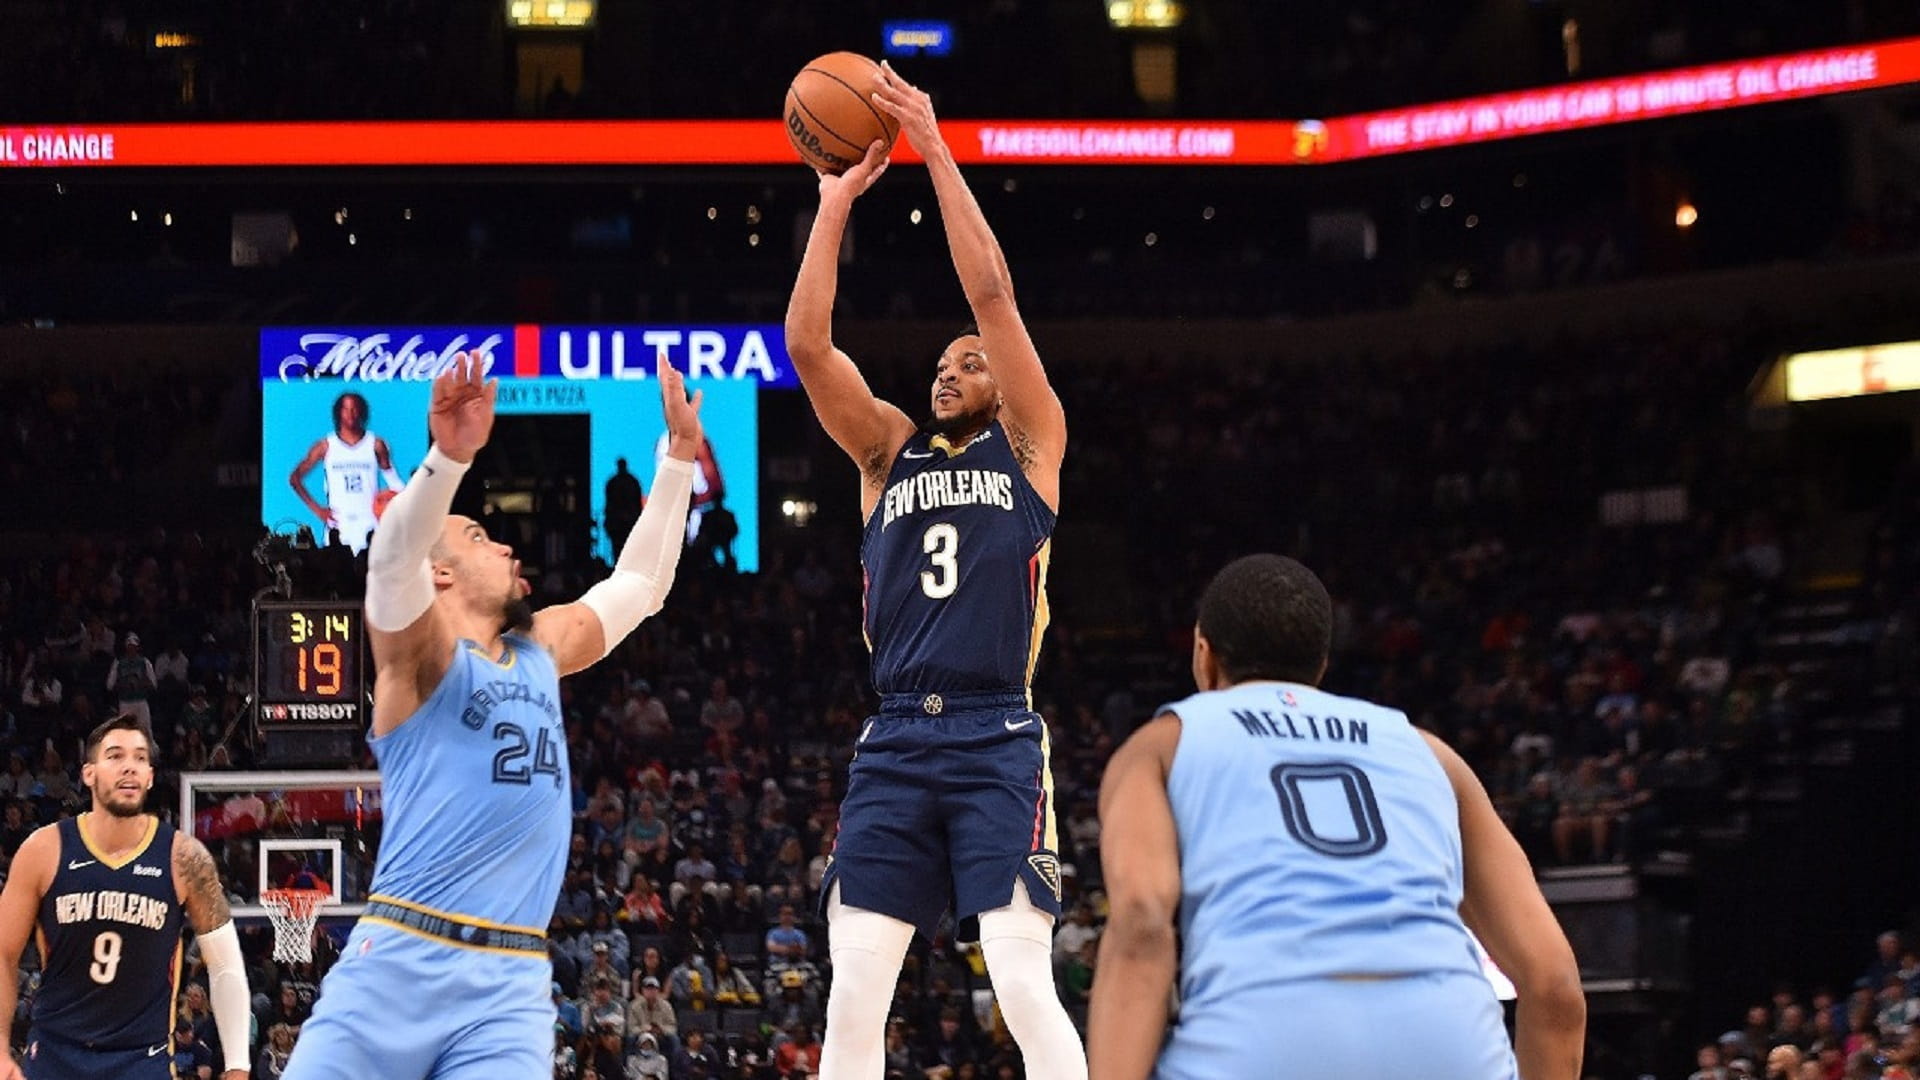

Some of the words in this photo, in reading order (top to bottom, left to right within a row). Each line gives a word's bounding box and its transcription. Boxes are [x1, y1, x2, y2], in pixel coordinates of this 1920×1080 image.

[1736, 64, 1777, 98] OIL
[1777, 49, 1879, 92] CHANGE
[0, 134, 18, 161] IL
[22, 133, 115, 161] CHANGE
[788, 107, 858, 172] Wilson
[558, 330, 777, 381] ULTRA
[916, 470, 1014, 511] ORLEANS
[920, 523, 960, 599] 3
[290, 612, 349, 643] 3:14
[298, 643, 341, 695] 19
[287, 703, 357, 720] TISSOT
[1230, 708, 1369, 745] MELTON
[491, 721, 562, 788] 24
[1269, 761, 1389, 861] 0
[55, 891, 97, 925] NEW
[96, 890, 168, 931] ORLEANS
[88, 931, 123, 985] 9
